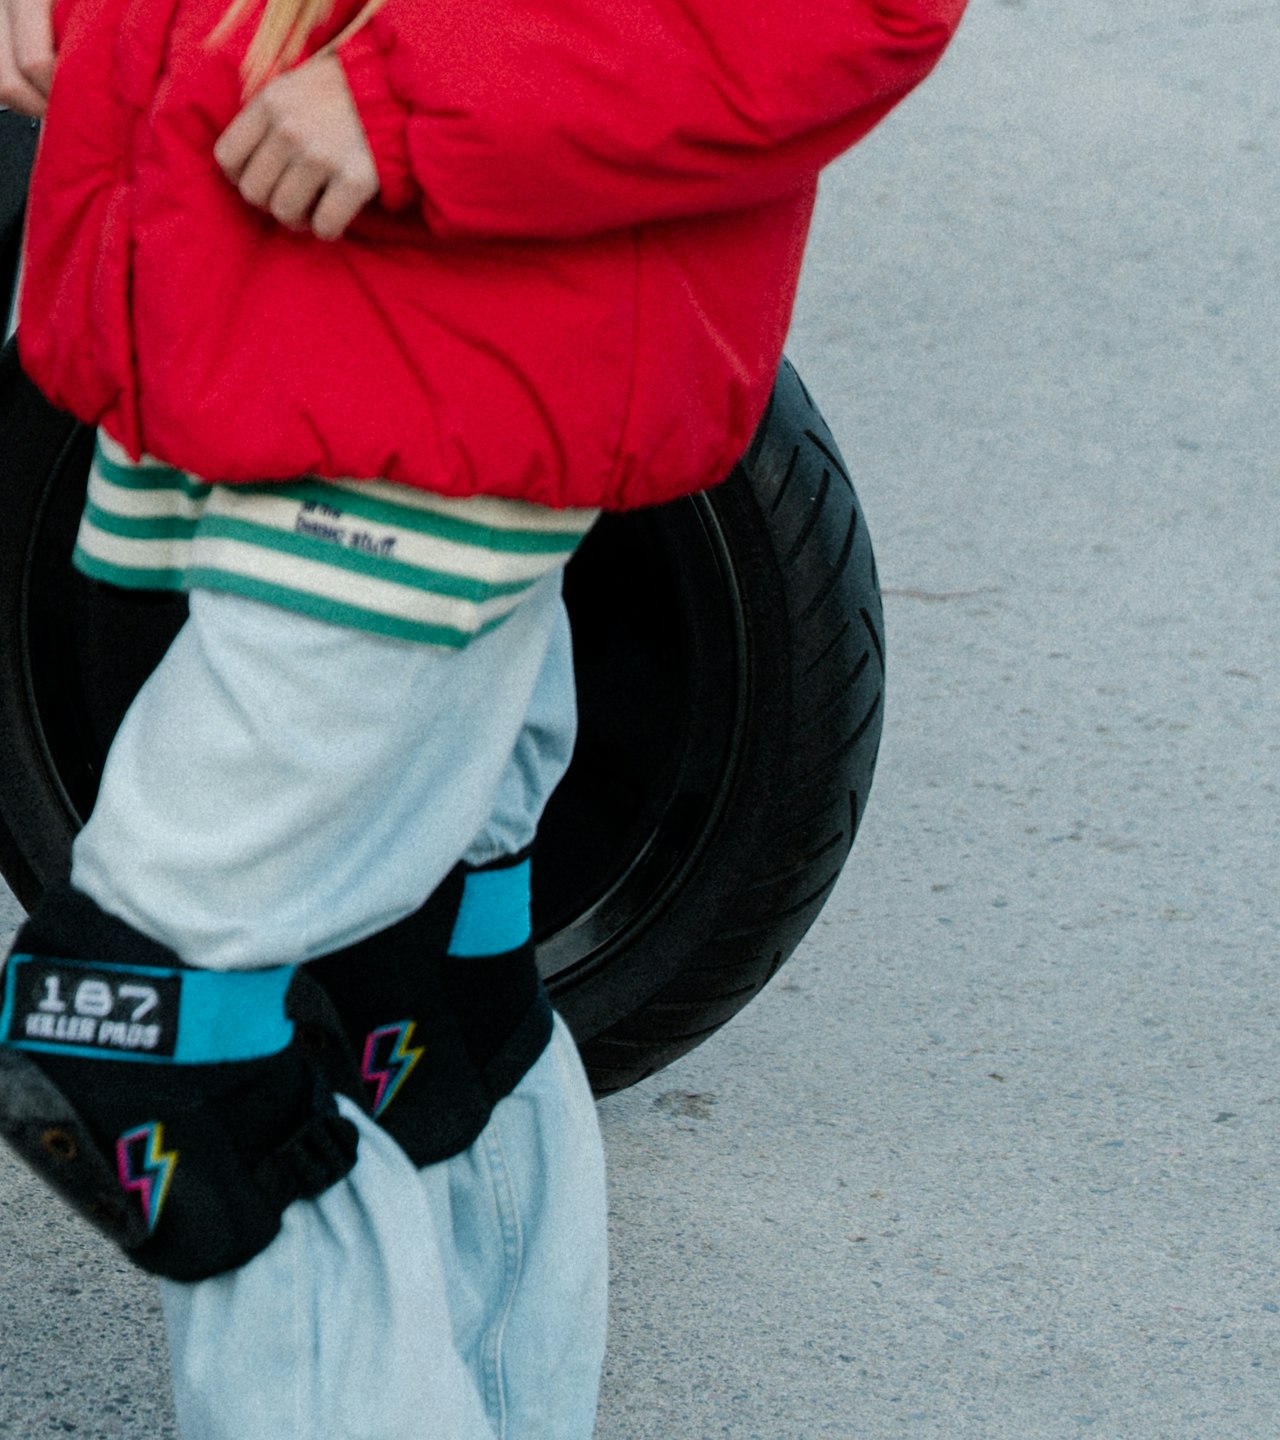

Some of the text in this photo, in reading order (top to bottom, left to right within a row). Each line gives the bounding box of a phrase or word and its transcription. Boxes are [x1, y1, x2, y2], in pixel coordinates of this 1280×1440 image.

[38, 975, 159, 1021] 187
[25, 1012, 161, 1050] KILLER PADS
